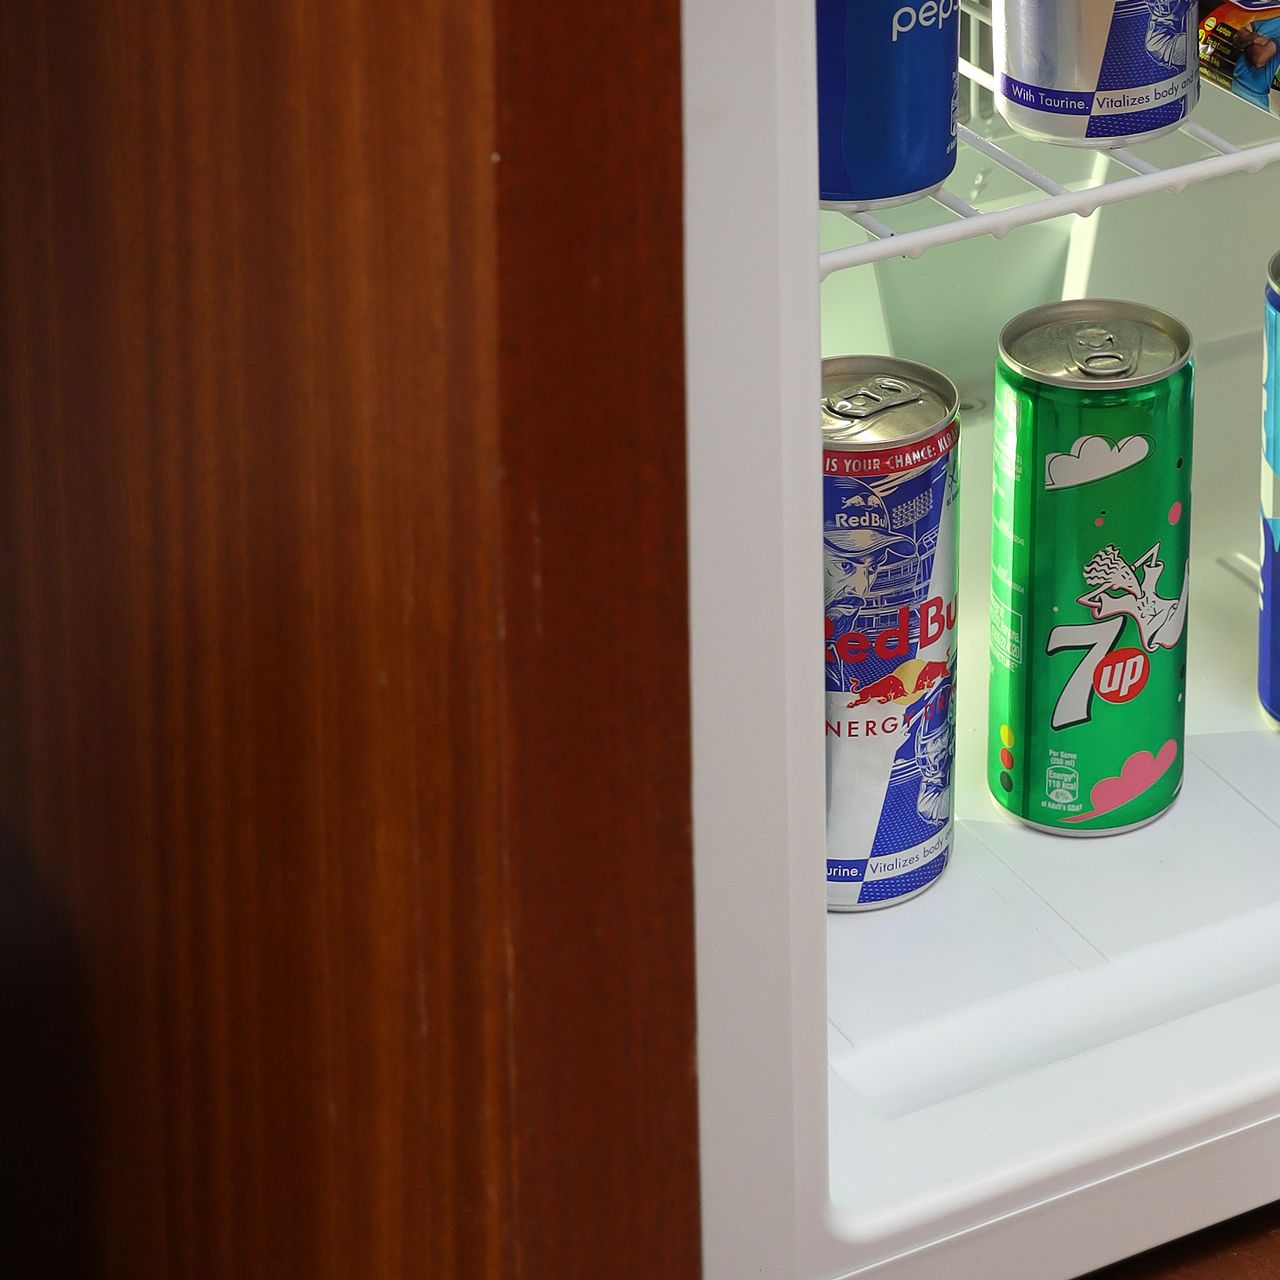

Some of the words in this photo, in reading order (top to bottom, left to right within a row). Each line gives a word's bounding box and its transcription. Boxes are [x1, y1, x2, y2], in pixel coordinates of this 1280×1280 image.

[1011, 84, 1035, 104] With
[1038, 92, 1089, 110] Taurine.
[1096, 93, 1150, 110] Vitalizes
[1154, 81, 1179, 101] body
[826, 456, 838, 472] IS
[843, 458, 881, 473] YOUR
[887, 443, 938, 470] CHANCE:
[835, 512, 868, 527] Red
[1046, 615, 1126, 732] 7
[1099, 654, 1144, 697] up
[825, 709, 914, 738] NERGY
[870, 852, 920, 874] Vitalizes
[922, 836, 943, 859] body
